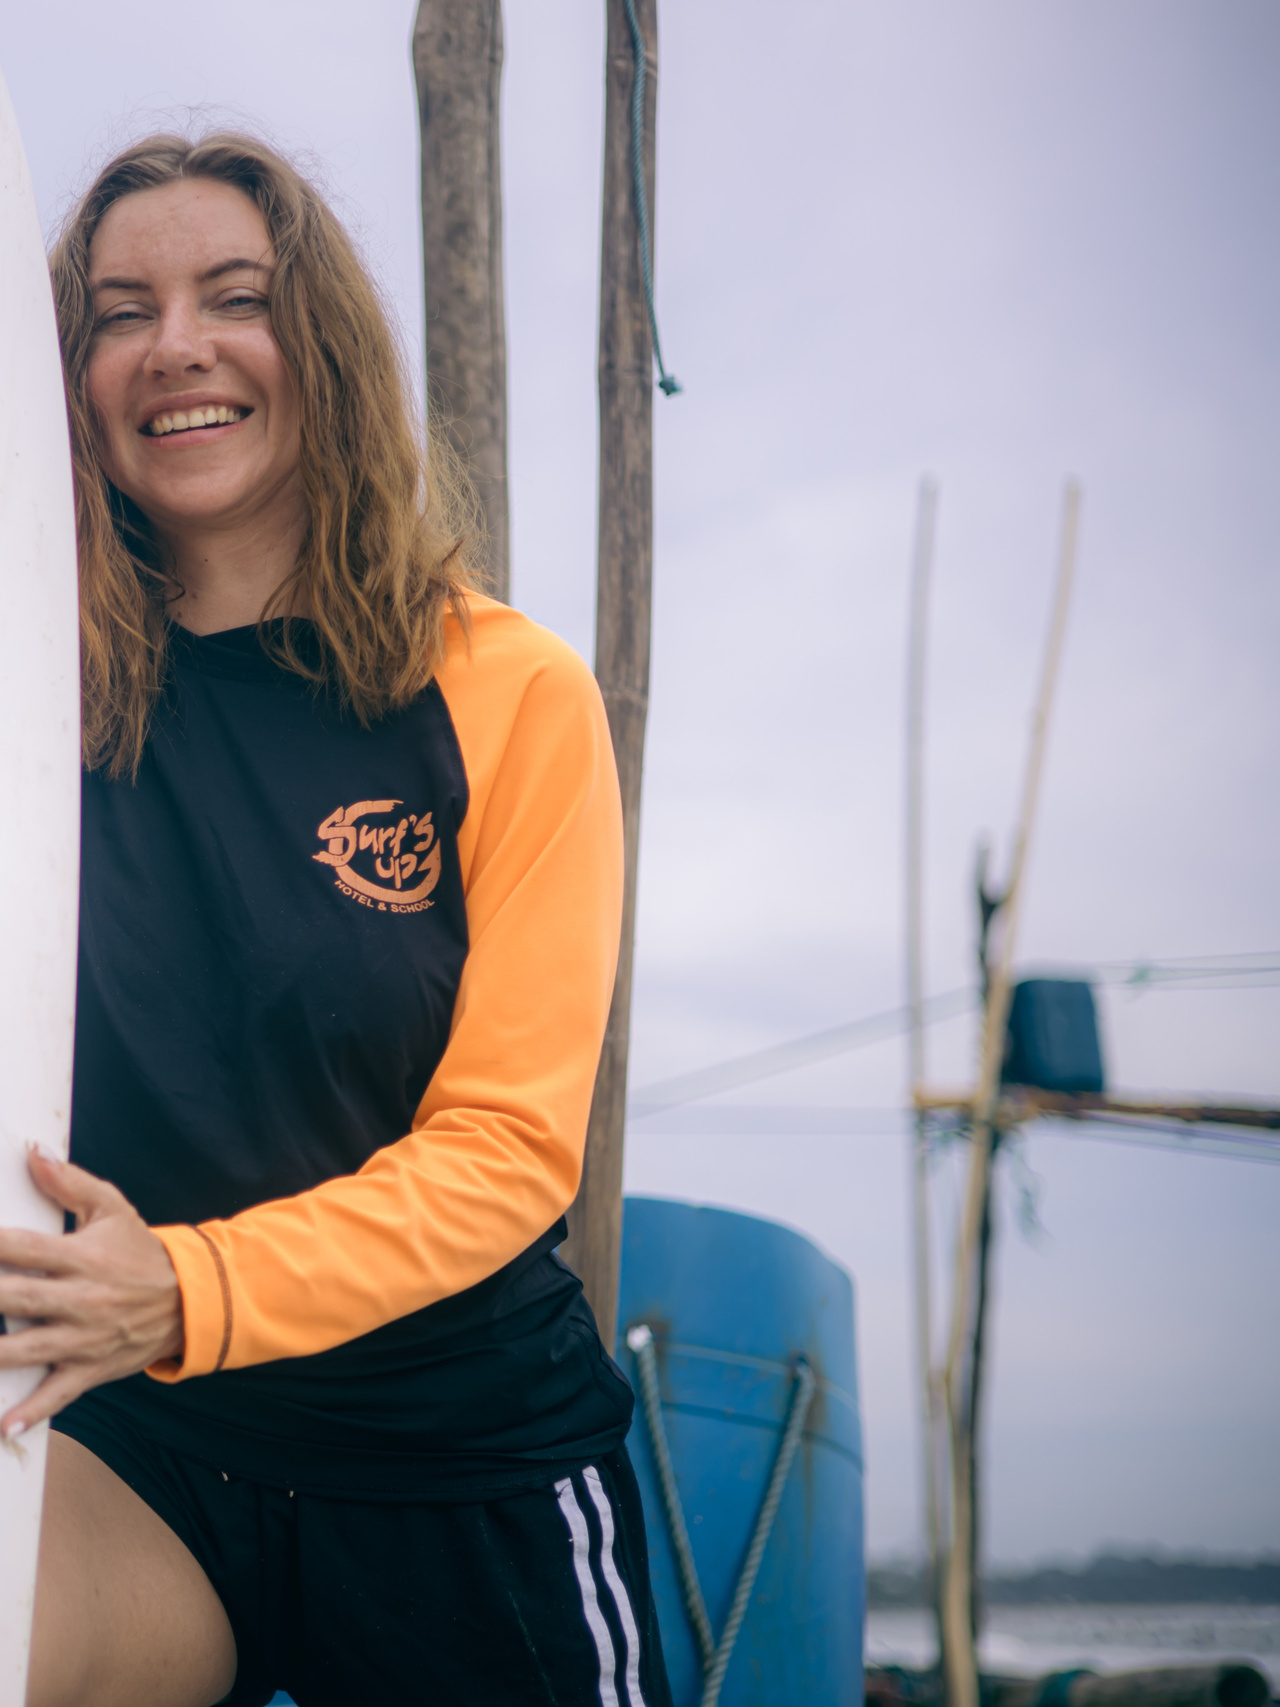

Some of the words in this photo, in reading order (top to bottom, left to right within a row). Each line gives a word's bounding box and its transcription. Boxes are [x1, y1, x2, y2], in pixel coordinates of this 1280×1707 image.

[312, 800, 434, 867] Surf's
[334, 880, 374, 908] HOTEL
[377, 902, 387, 911] &
[390, 898, 435, 913] SCHOOL
